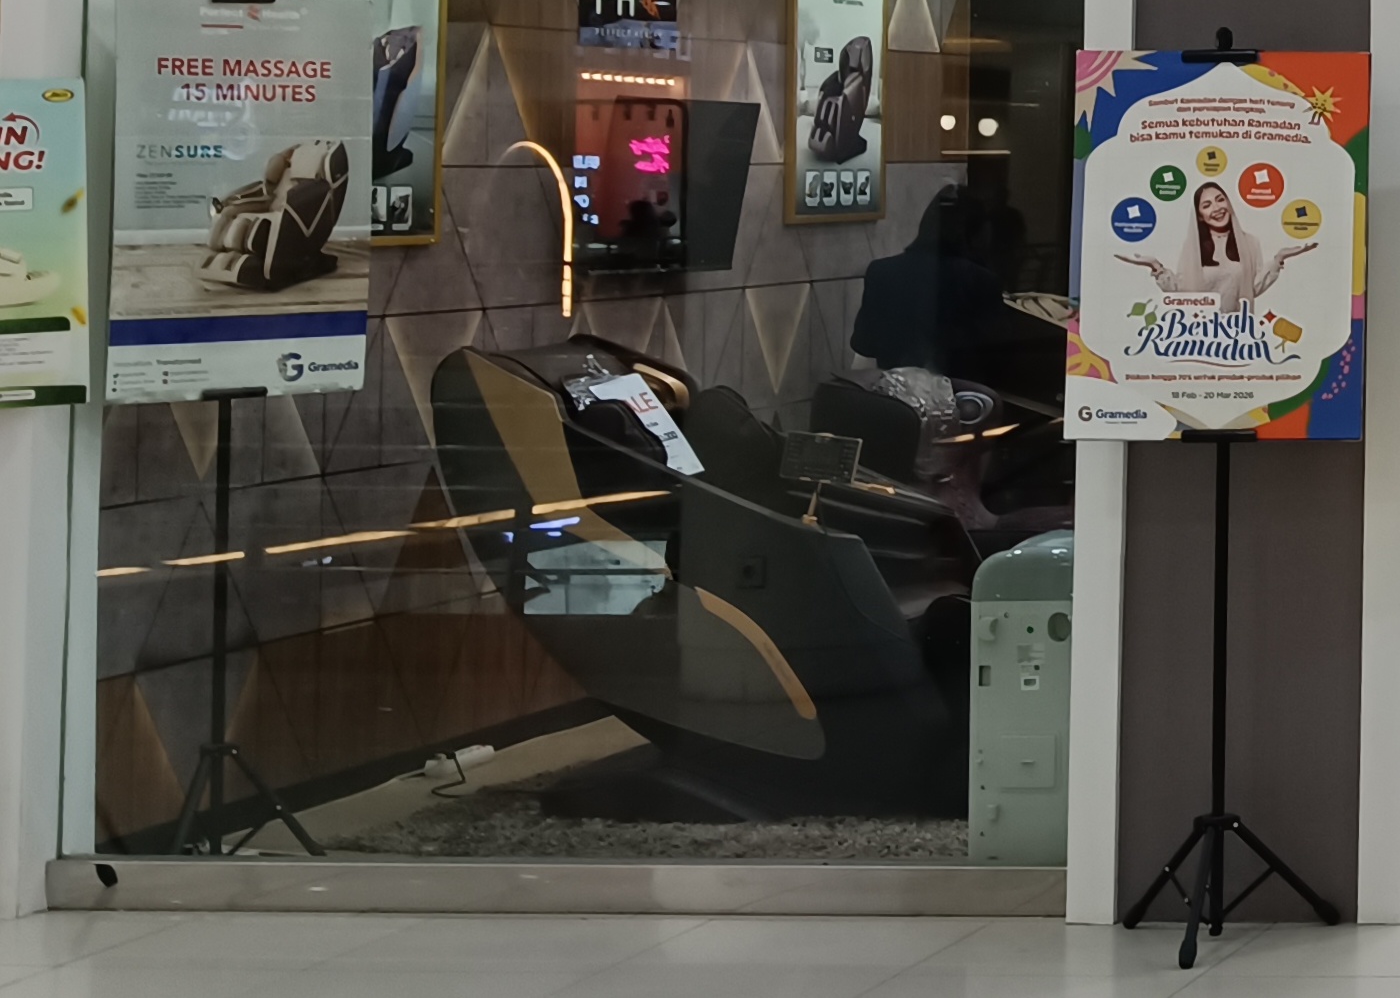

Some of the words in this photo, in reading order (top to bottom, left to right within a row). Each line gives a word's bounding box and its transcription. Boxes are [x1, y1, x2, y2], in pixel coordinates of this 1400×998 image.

[157, 57, 214, 77] FREE
[222, 58, 332, 79] MASSAGE
[181, 83, 206, 101] 15
[215, 83, 316, 103] MINUTES
[1141, 118, 1179, 130] Semua
[1182, 118, 1245, 128] kebutuhan
[1247, 118, 1301, 131] Ramadan
[1129, 132, 1152, 143] bisa
[1155, 131, 1186, 140] kamu
[1189, 129, 1240, 140] temukan
[1241, 130, 1252, 140] di
[136, 144, 223, 159] ZENSURE
[1163, 296, 1216, 306] Gramedia
[1161, 300, 1265, 342] Berkah
[1124, 324, 1302, 365] Ramadan
[308, 359, 359, 373] Gramedia
[1096, 408, 1147, 420] Gramedia
